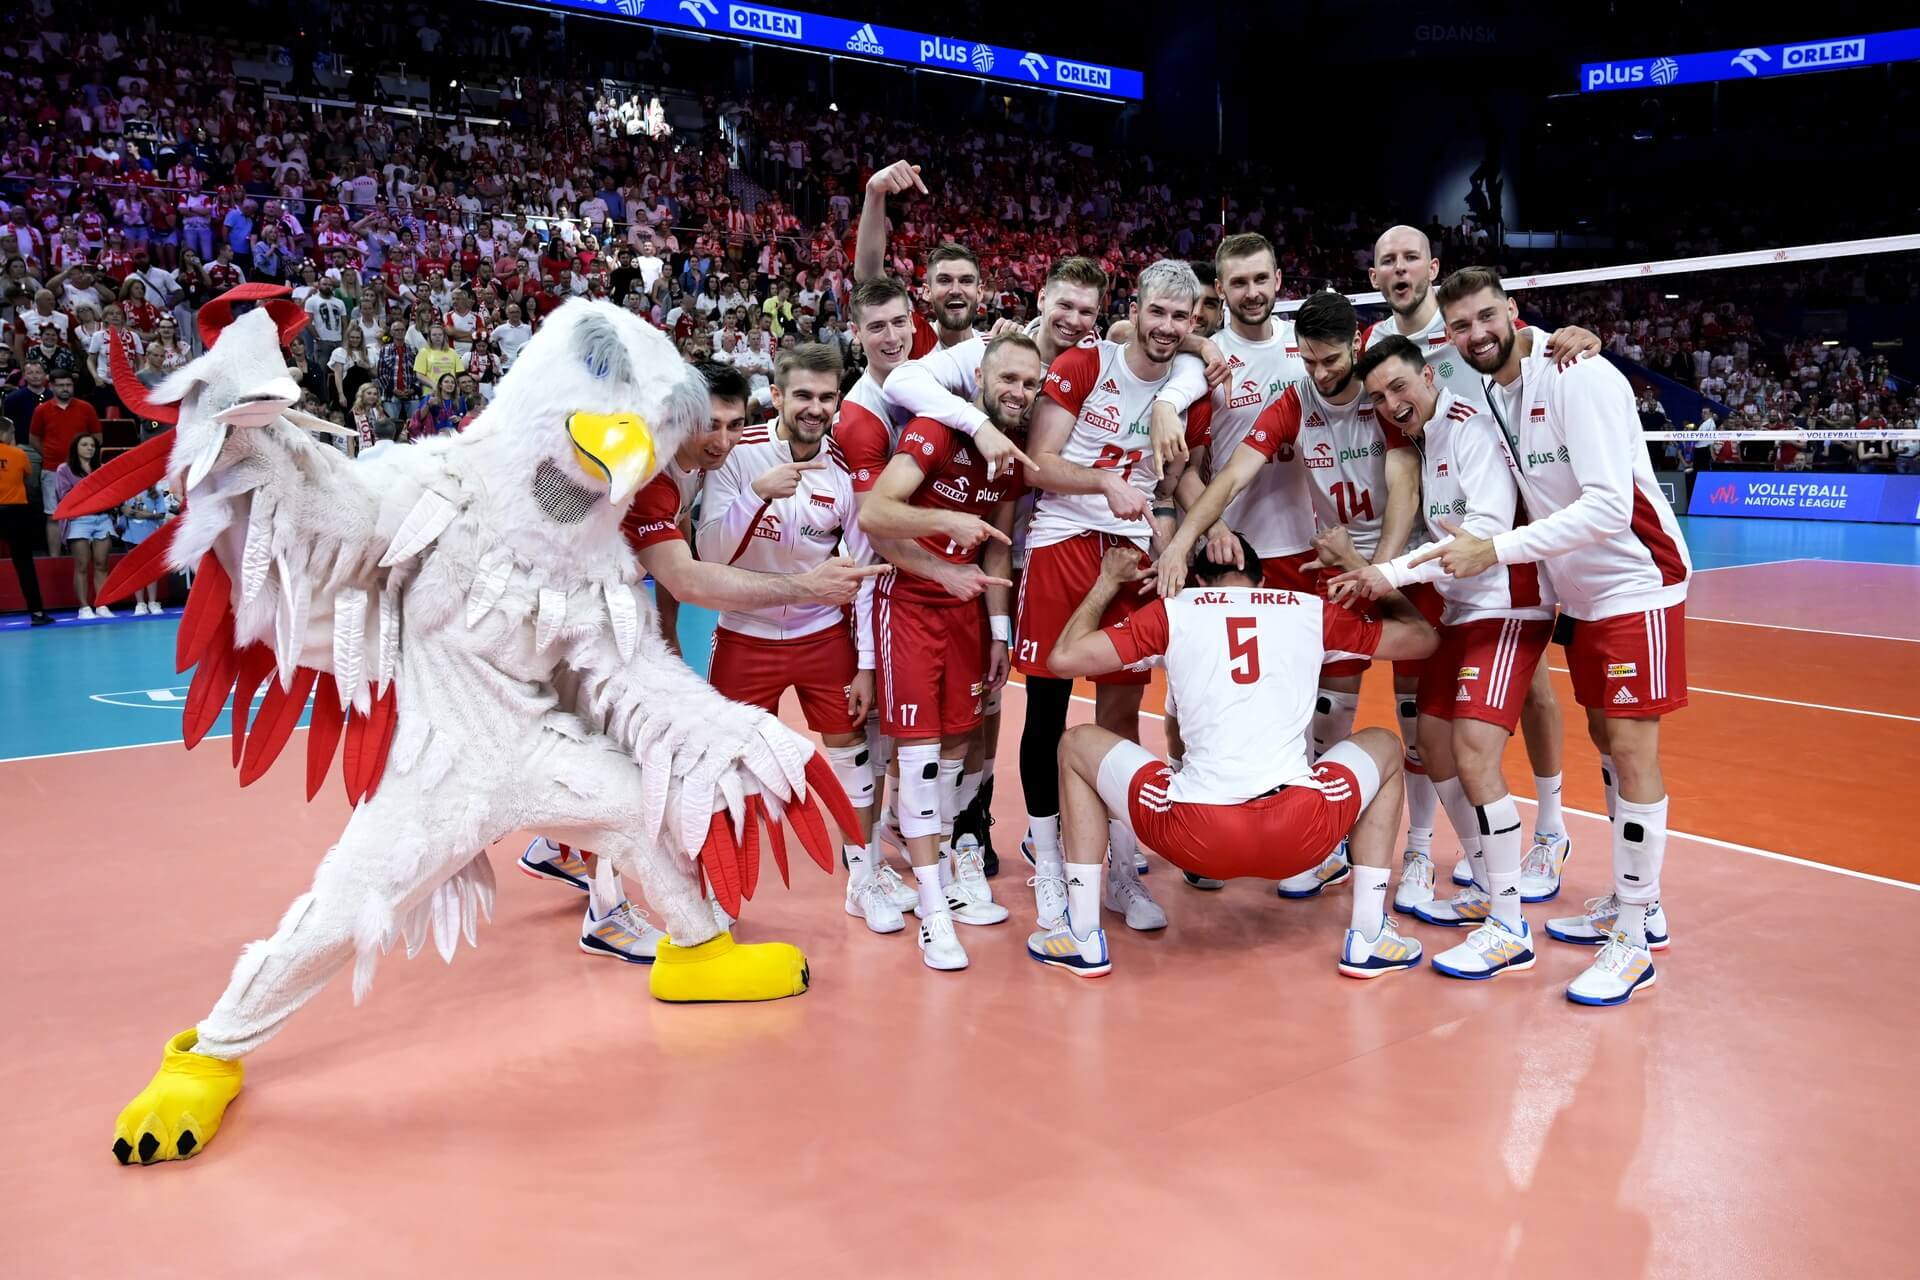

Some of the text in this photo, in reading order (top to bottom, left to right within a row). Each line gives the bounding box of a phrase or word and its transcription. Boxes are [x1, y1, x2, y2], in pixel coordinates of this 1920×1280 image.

[733, 9, 797, 34] ORLEN
[846, 40, 884, 55] adidas
[920, 37, 967, 62] plus
[1787, 43, 1860, 65] ORLEN
[1060, 64, 1108, 87] ORLEN
[1588, 64, 1644, 90] plus
[1231, 394, 1260, 408] ORLEN
[1087, 415, 1119, 431] ORLEN
[1128, 422, 1150, 435] plu
[905, 432, 925, 443] plus
[953, 457, 972, 466] adidas
[1340, 448, 1369, 463] plus
[935, 483, 966, 501] ORLEN
[975, 488, 999, 502] plus
[1748, 483, 1848, 498] VOLLEYBALL
[1330, 481, 1375, 524] 14
[1430, 501, 1450, 518] plus
[1745, 497, 1846, 508] NATIONS LEAGUE
[638, 521, 664, 536] plus
[754, 527, 779, 540] RLEN
[1019, 639, 1039, 662] 21
[1225, 617, 1260, 684] 5
[900, 704, 918, 726] 17
